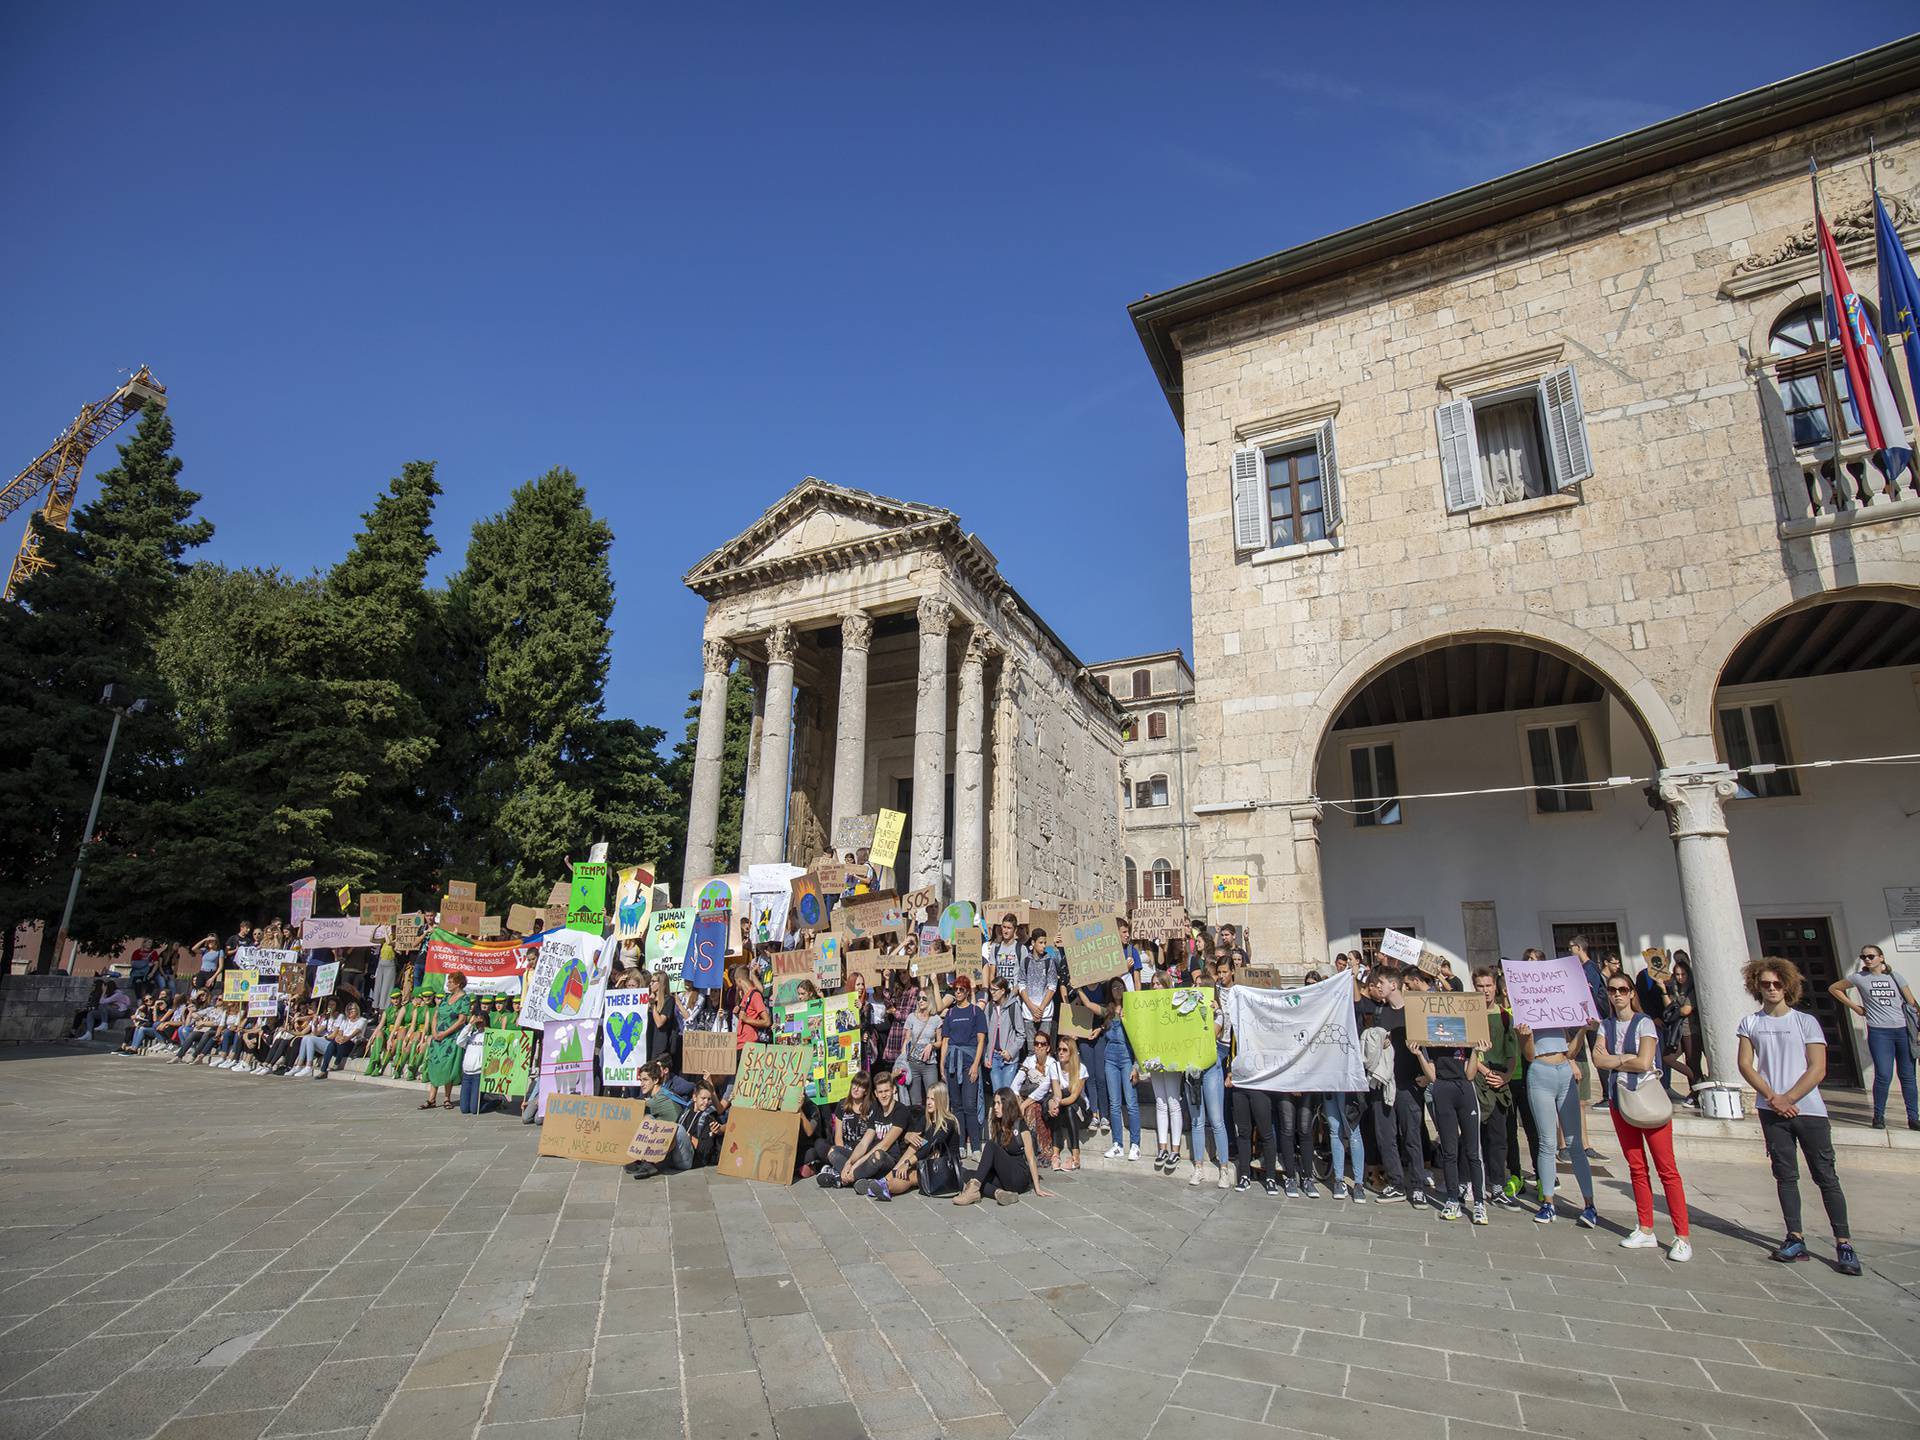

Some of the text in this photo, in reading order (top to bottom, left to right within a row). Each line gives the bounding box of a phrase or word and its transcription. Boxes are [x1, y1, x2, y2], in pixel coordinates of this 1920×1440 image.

[580, 865, 606, 876] TEMPO
[701, 898, 732, 910] DO NOT
[907, 889, 930, 911] SOS
[567, 911, 603, 925] STRINGE
[658, 911, 686, 923] HUMAN
[1160, 907, 1172, 918] SE
[398, 918, 412, 926] THE
[654, 921, 686, 932] CHANGE
[1133, 920, 1146, 930] ZA
[1148, 919, 1165, 929] ONO
[1066, 934, 1119, 958] PLANETA
[661, 956, 673, 964] NOT
[1071, 950, 1121, 978] ZEMLJE
[653, 962, 683, 972] CLIMATE
[821, 977, 840, 988] PROFIT
[606, 994, 631, 1007] THERE
[632, 994, 639, 1006] IS
[1420, 996, 1457, 1014] YEAR
[745, 1047, 803, 1073] ŠKOLSKI
[604, 1066, 635, 1082] PLANET
[789, 1072, 805, 1087] ZA
[484, 1077, 496, 1093] TO
